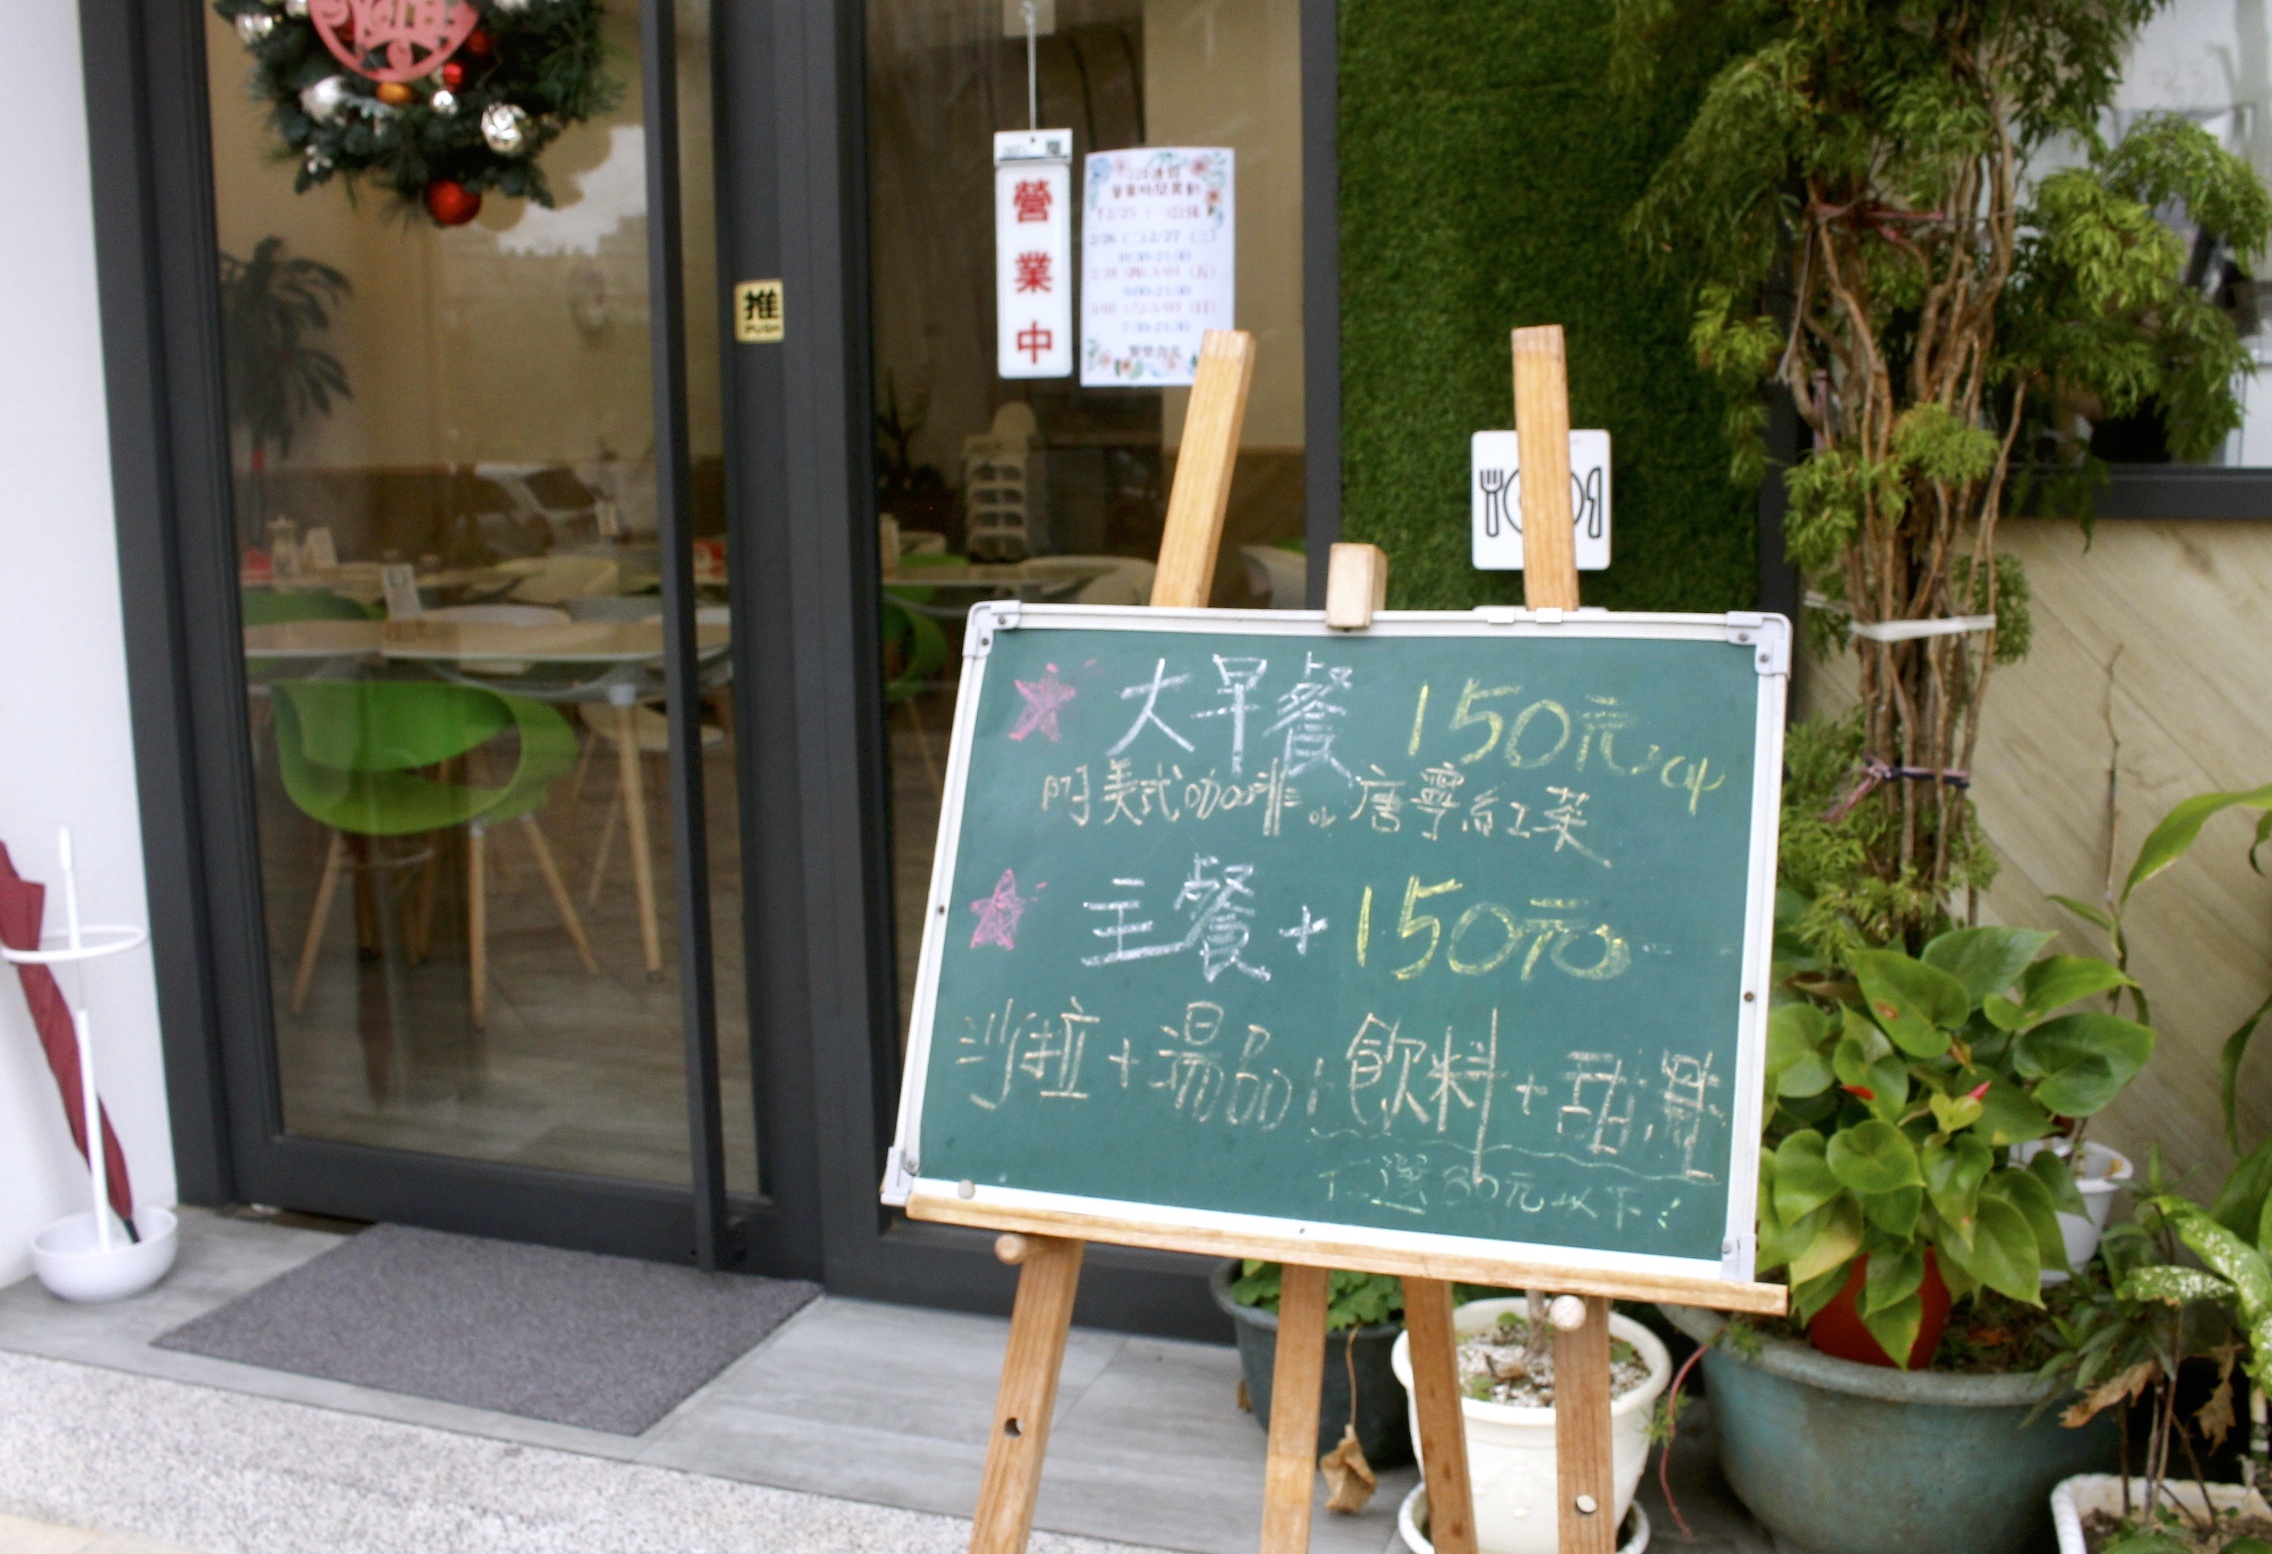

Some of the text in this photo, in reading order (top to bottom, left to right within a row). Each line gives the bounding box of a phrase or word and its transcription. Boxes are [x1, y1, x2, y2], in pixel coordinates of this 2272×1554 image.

[744, 288, 779, 320] 推
[1012, 179, 1055, 366] 營業中
[1106, 651, 1354, 788] 大早餐
